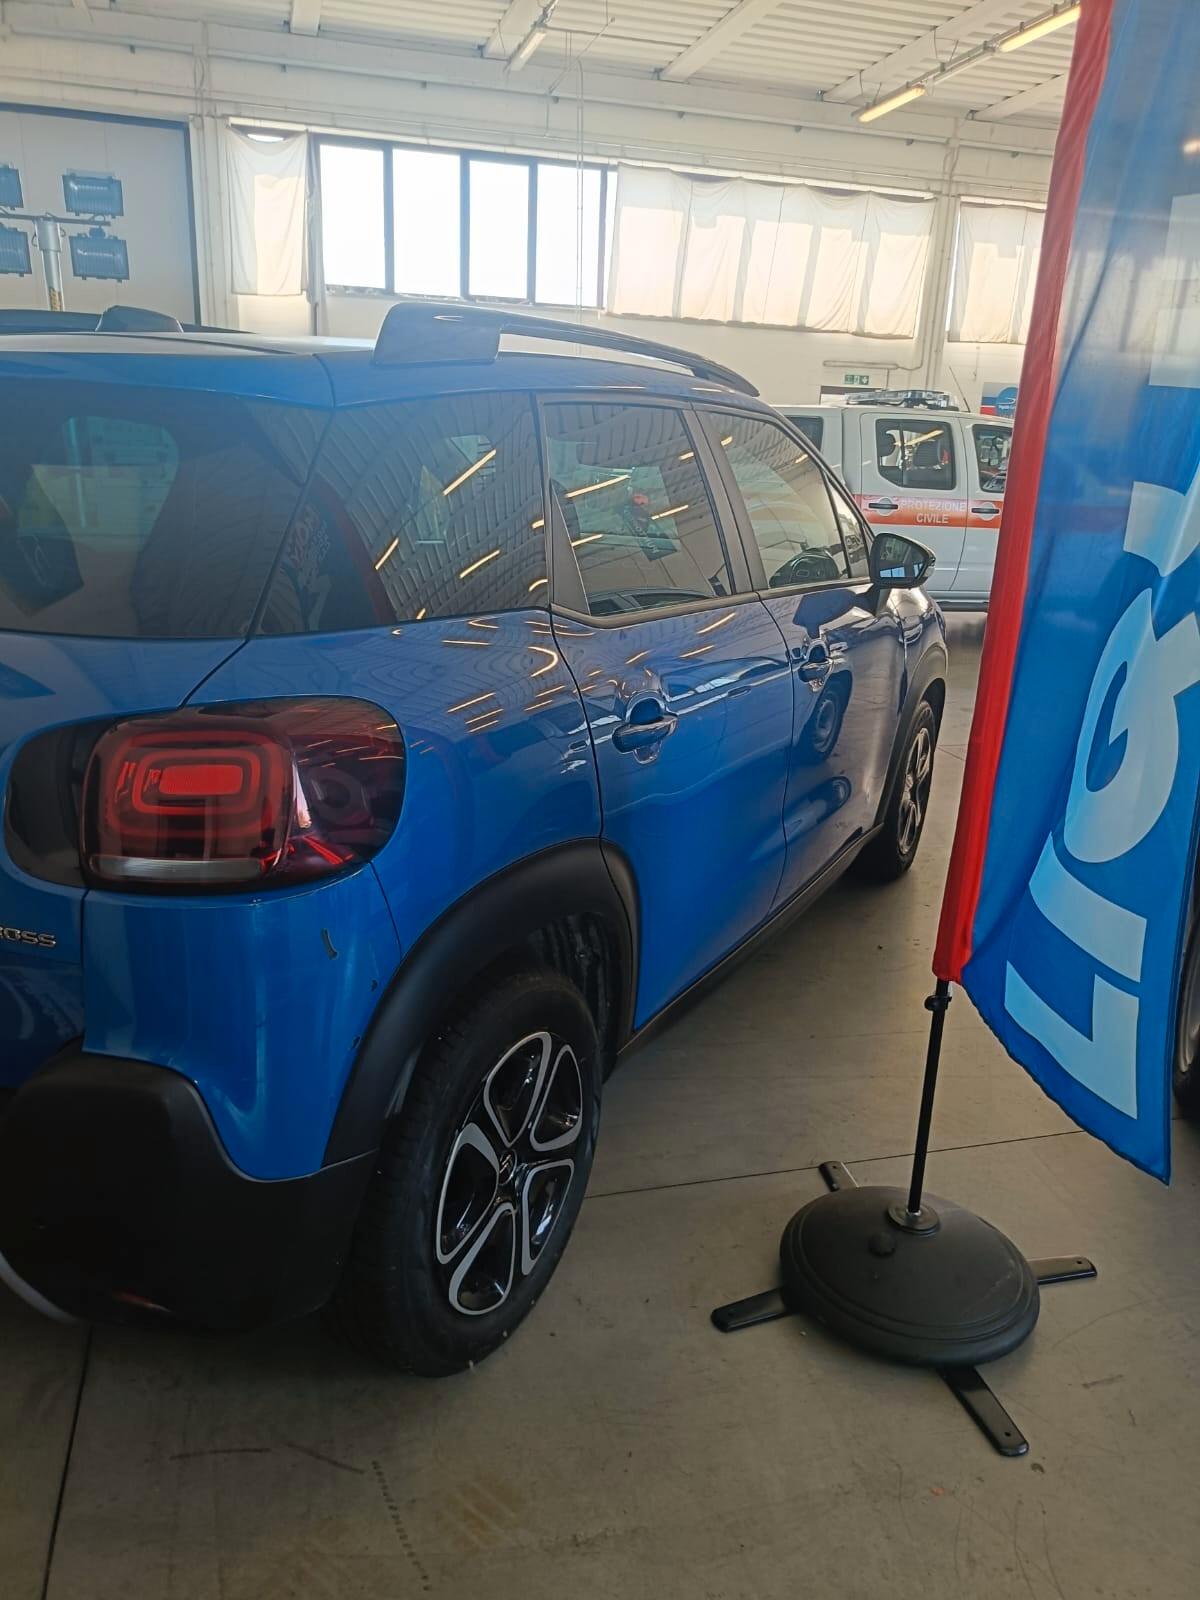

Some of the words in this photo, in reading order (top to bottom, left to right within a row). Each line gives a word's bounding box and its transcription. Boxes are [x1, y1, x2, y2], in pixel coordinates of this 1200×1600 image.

[901, 499, 967, 512] PROTEZIONE
[916, 513, 949, 524] CIVILE
[0, 926, 56, 948] OSS
